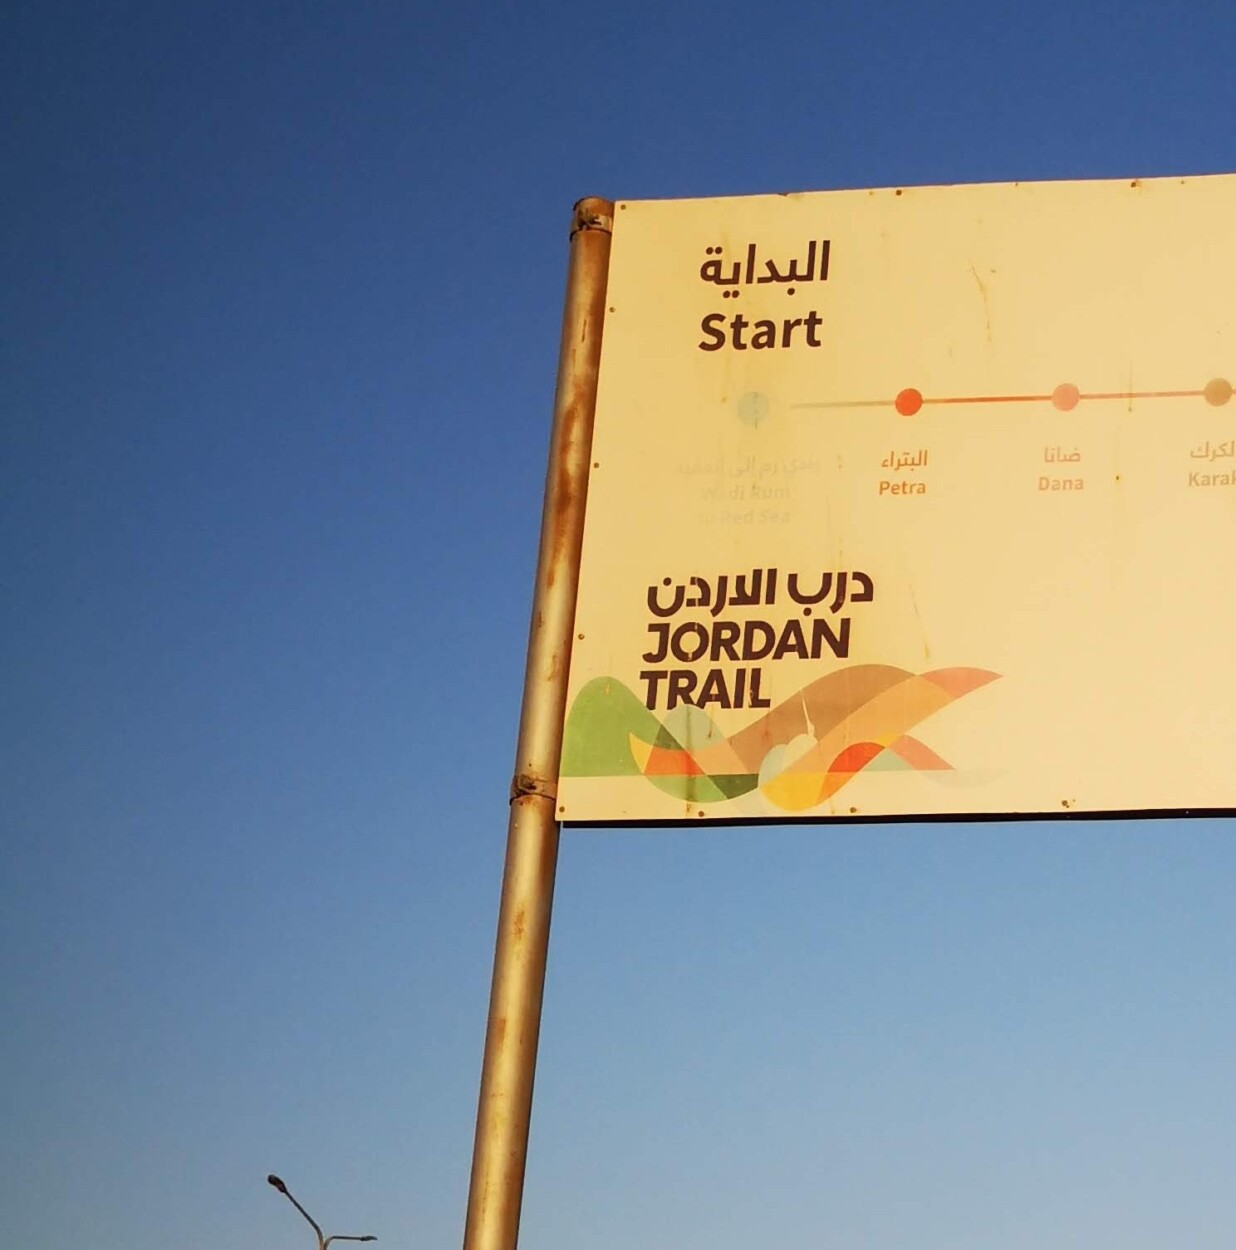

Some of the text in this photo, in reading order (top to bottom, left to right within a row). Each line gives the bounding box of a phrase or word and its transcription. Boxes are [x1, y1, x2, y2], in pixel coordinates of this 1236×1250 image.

[700, 240, 830, 298] البداية
[699, 311, 822, 351] Start
[881, 450, 928, 471] البتراء
[1044, 446, 1081, 463] ضانا
[750, 485, 790, 499] Rum
[879, 481, 926, 495] Petra
[1038, 476, 1084, 491] Dana
[720, 510, 753, 525] Red
[787, 570, 874, 616] درب
[642, 617, 851, 663] JORDAN
[640, 668, 772, 711] TRAIL
